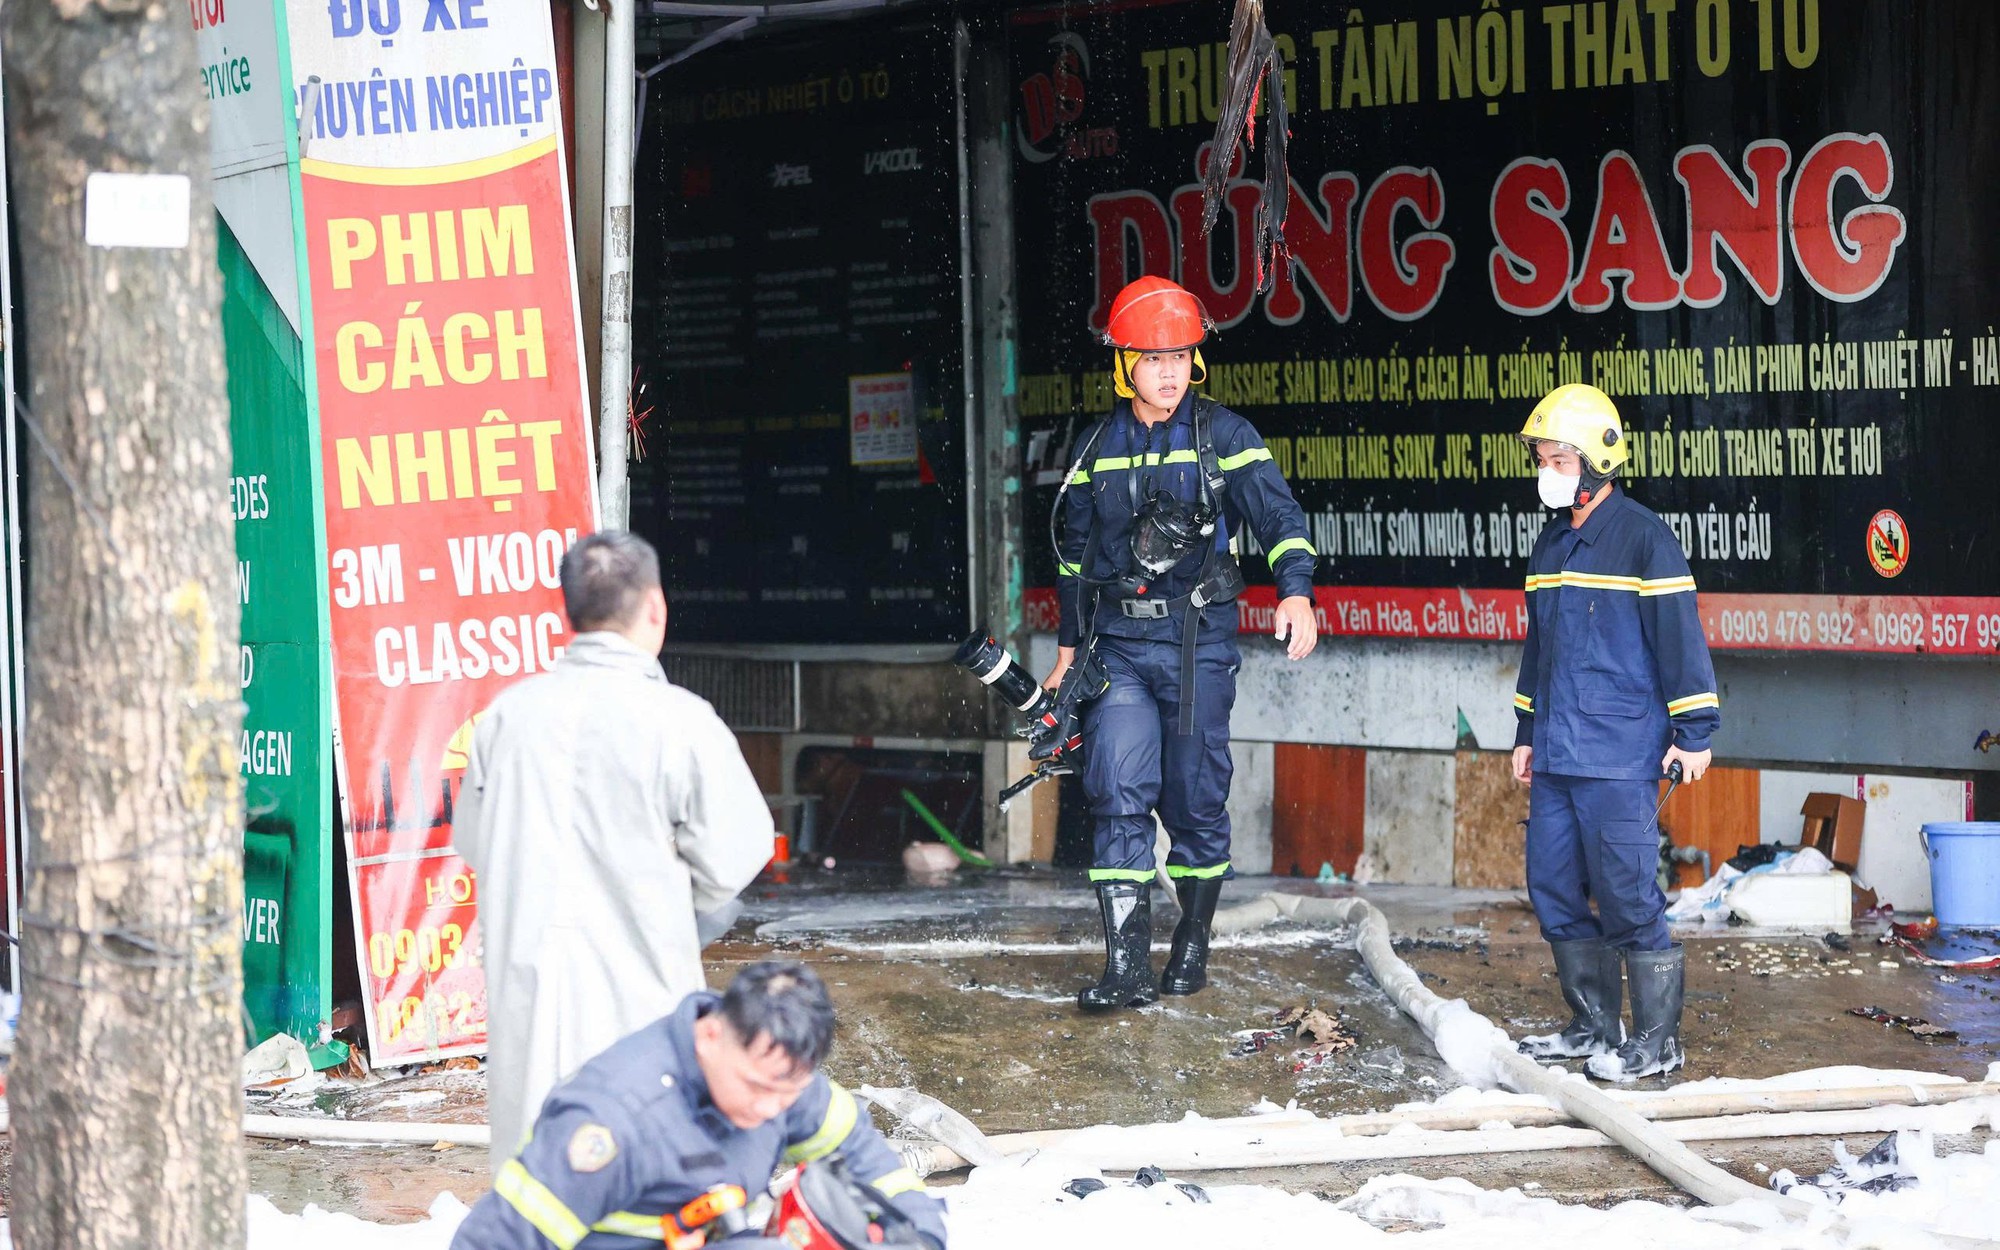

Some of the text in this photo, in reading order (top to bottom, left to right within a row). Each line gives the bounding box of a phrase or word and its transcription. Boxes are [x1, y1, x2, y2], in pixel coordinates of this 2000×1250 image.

[426, 57, 553, 137] NGHIỆP
[1141, 34, 1297, 128] TRUG
[1312, 8, 1418, 112] TÂM
[1437, 0, 1526, 116] NỘI
[326, 204, 536, 291] PHIM
[1489, 132, 1907, 317] SANG
[334, 301, 549, 395] CÁCH
[1210, 361, 1281, 407] MASSAGE
[1319, 359, 1341, 403] DA
[1343, 357, 1374, 402] CAO
[1378, 342, 1413, 406] CẤP,
[1415, 347, 1459, 401] CÁCH
[1463, 345, 1494, 404] ÂM,
[1498, 336, 1554, 400] CHỐNG
[1592, 333, 1651, 397] CHỐNG
[1655, 338, 1710, 400] NÓNG,
[1714, 336, 1752, 393] DÁN
[1756, 344, 1804, 393] PHIM
[1809, 332, 1859, 391] CÁCH
[1864, 329, 1919, 400] NHIỆT
[1924, 328, 1953, 388] MỸ
[1972, 325, 2000, 387] HÀ
[336, 409, 563, 513] NHIỆT
[1296, 427, 1343, 480] CHÍNH
[1394, 434, 1439, 484] SONY,
[1442, 433, 1478, 484] JVC,
[1650, 414, 1675, 478] ĐỒ
[1679, 425, 1721, 478] CHƠI
[1724, 428, 1784, 478] TRANG
[1787, 418, 1817, 477] TRÍ
[1821, 427, 1846, 477] XE
[1850, 422, 1883, 477] HƠI
[1314, 502, 1342, 566] NỘI
[1344, 497, 1384, 557] THẤT
[1387, 507, 1419, 558] SƠN
[1424, 507, 1469, 567] NHỰA
[1473, 512, 1486, 558] &
[1489, 502, 1513, 568] ĐỘ
[1699, 502, 1731, 560] YÊU
[1735, 496, 1772, 561] CẦU
[332, 543, 405, 609] 3M
[374, 611, 566, 689] CLASSIC
[1237, 600, 1277, 629] Trun
[1337, 595, 1372, 632] Yên
[1377, 600, 1418, 636] Hòa,
[1422, 594, 1460, 634] Cầu
[1720, 609, 1768, 643] 0903
[1775, 610, 1811, 644] 476
[1817, 610, 1854, 645] 992
[1874, 612, 1925, 647] 0962
[1931, 613, 1970, 648] 567
